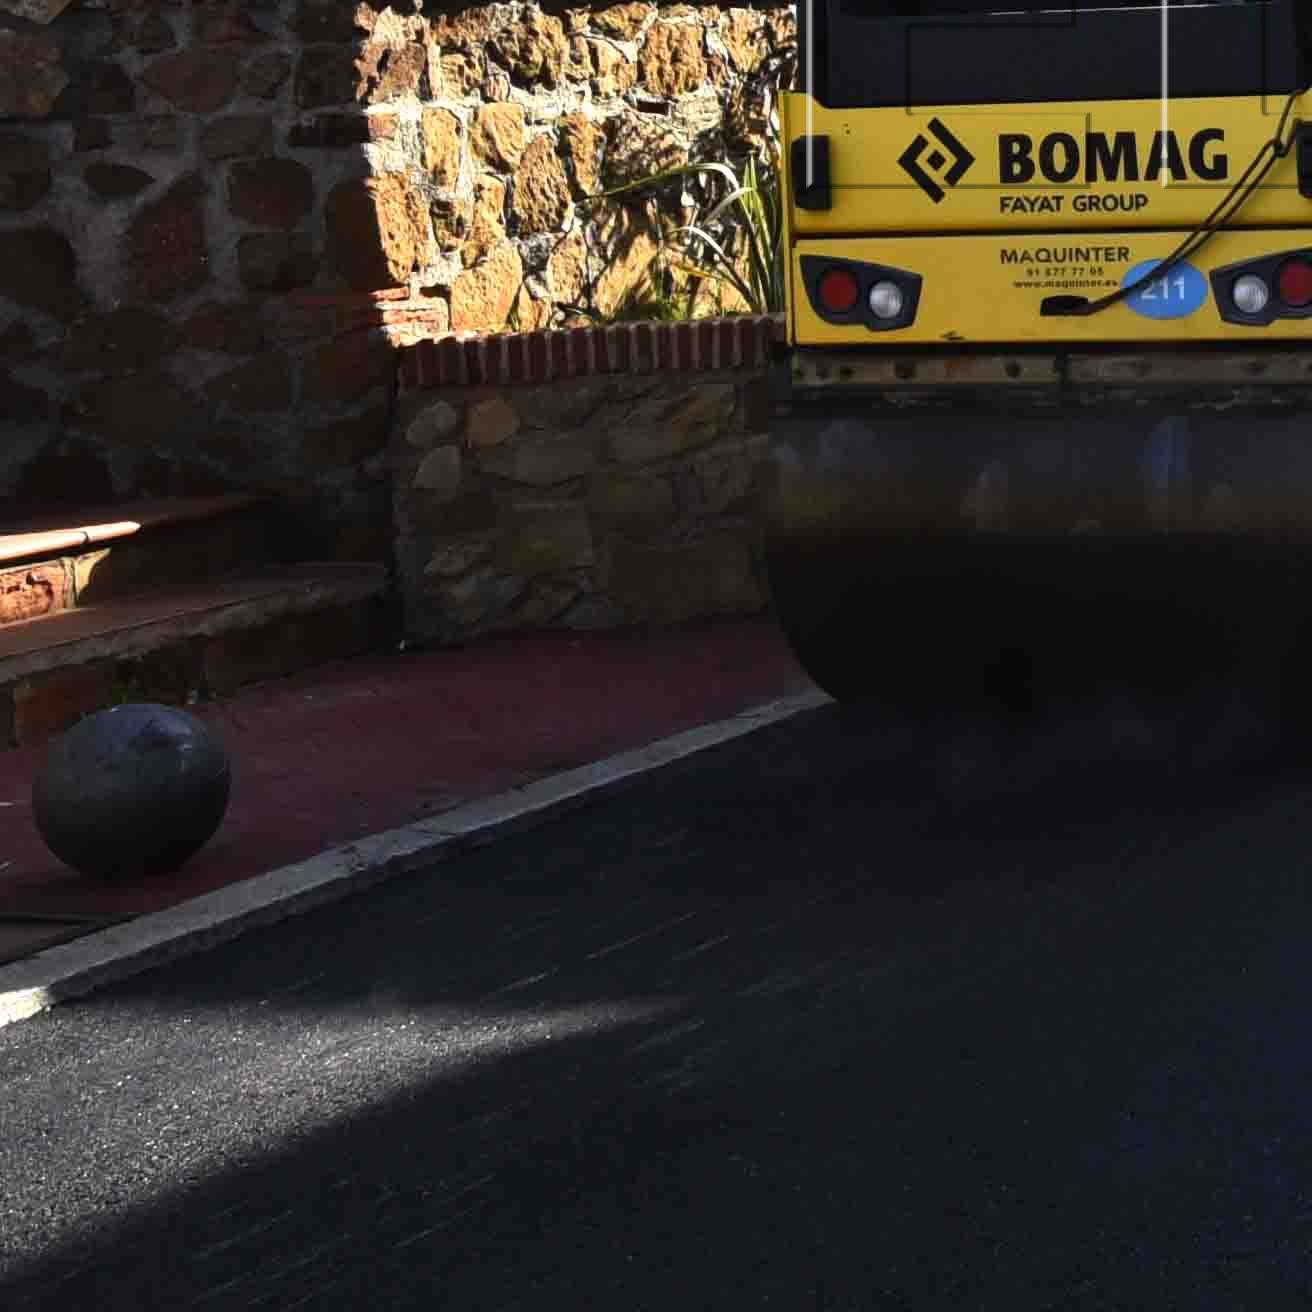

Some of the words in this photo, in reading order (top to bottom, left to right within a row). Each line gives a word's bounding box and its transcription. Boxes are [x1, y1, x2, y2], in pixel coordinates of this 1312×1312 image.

[999, 128, 1229, 185] BOMAG
[1000, 195, 1064, 213] FAYAT
[1072, 193, 1149, 212] GROUP
[1000, 246, 1130, 265] MAQUINTER
